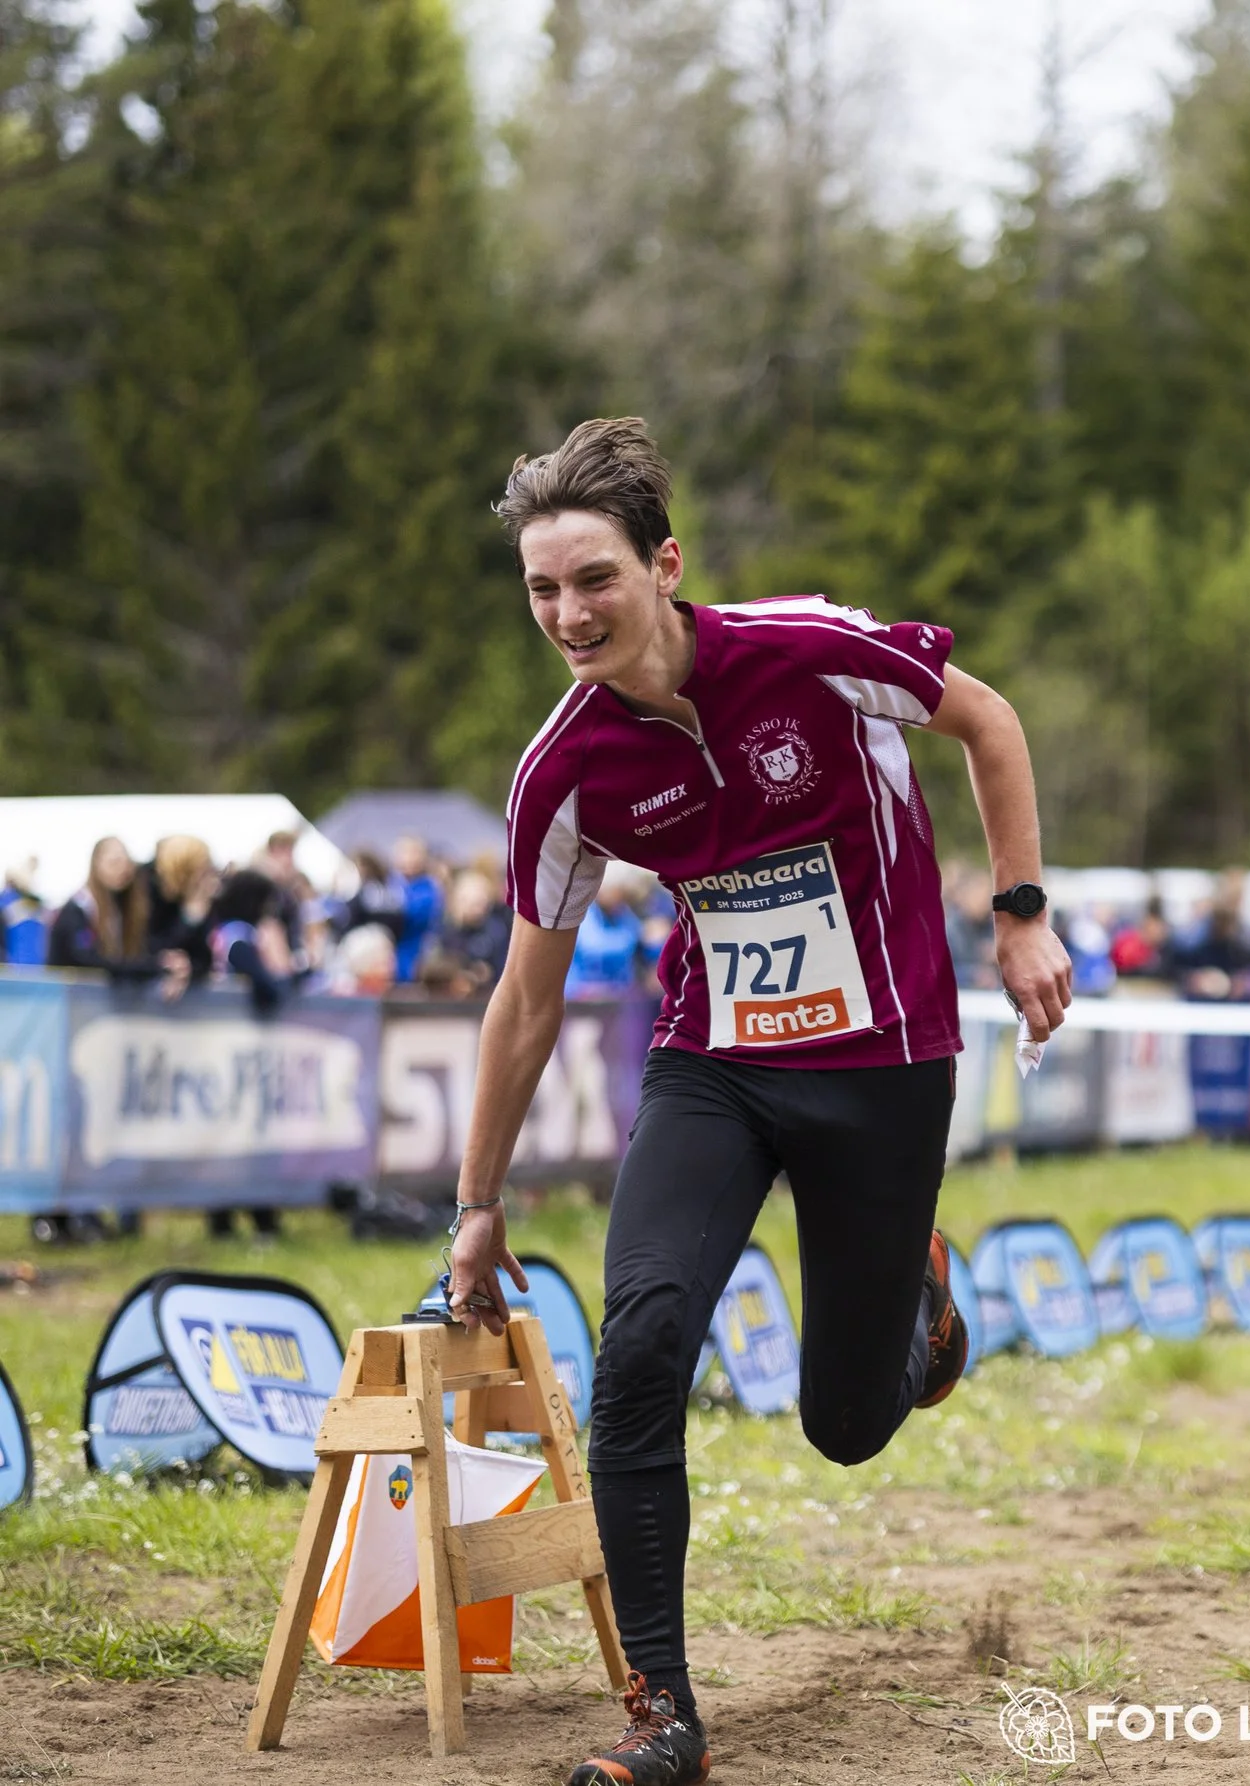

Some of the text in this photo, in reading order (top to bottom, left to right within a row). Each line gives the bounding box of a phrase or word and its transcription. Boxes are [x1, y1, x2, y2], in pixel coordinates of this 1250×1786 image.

[739, 717, 801, 752] RASBO IK
[630, 783, 687, 818] TRIMTEX
[764, 769, 822, 806] UPPSALA
[654, 814, 682, 832] Malthe
[716, 890, 805, 909] SM STAFETT 2025
[817, 902, 837, 931] 1
[711, 934, 808, 996] 727
[744, 1002, 838, 1037] renta
